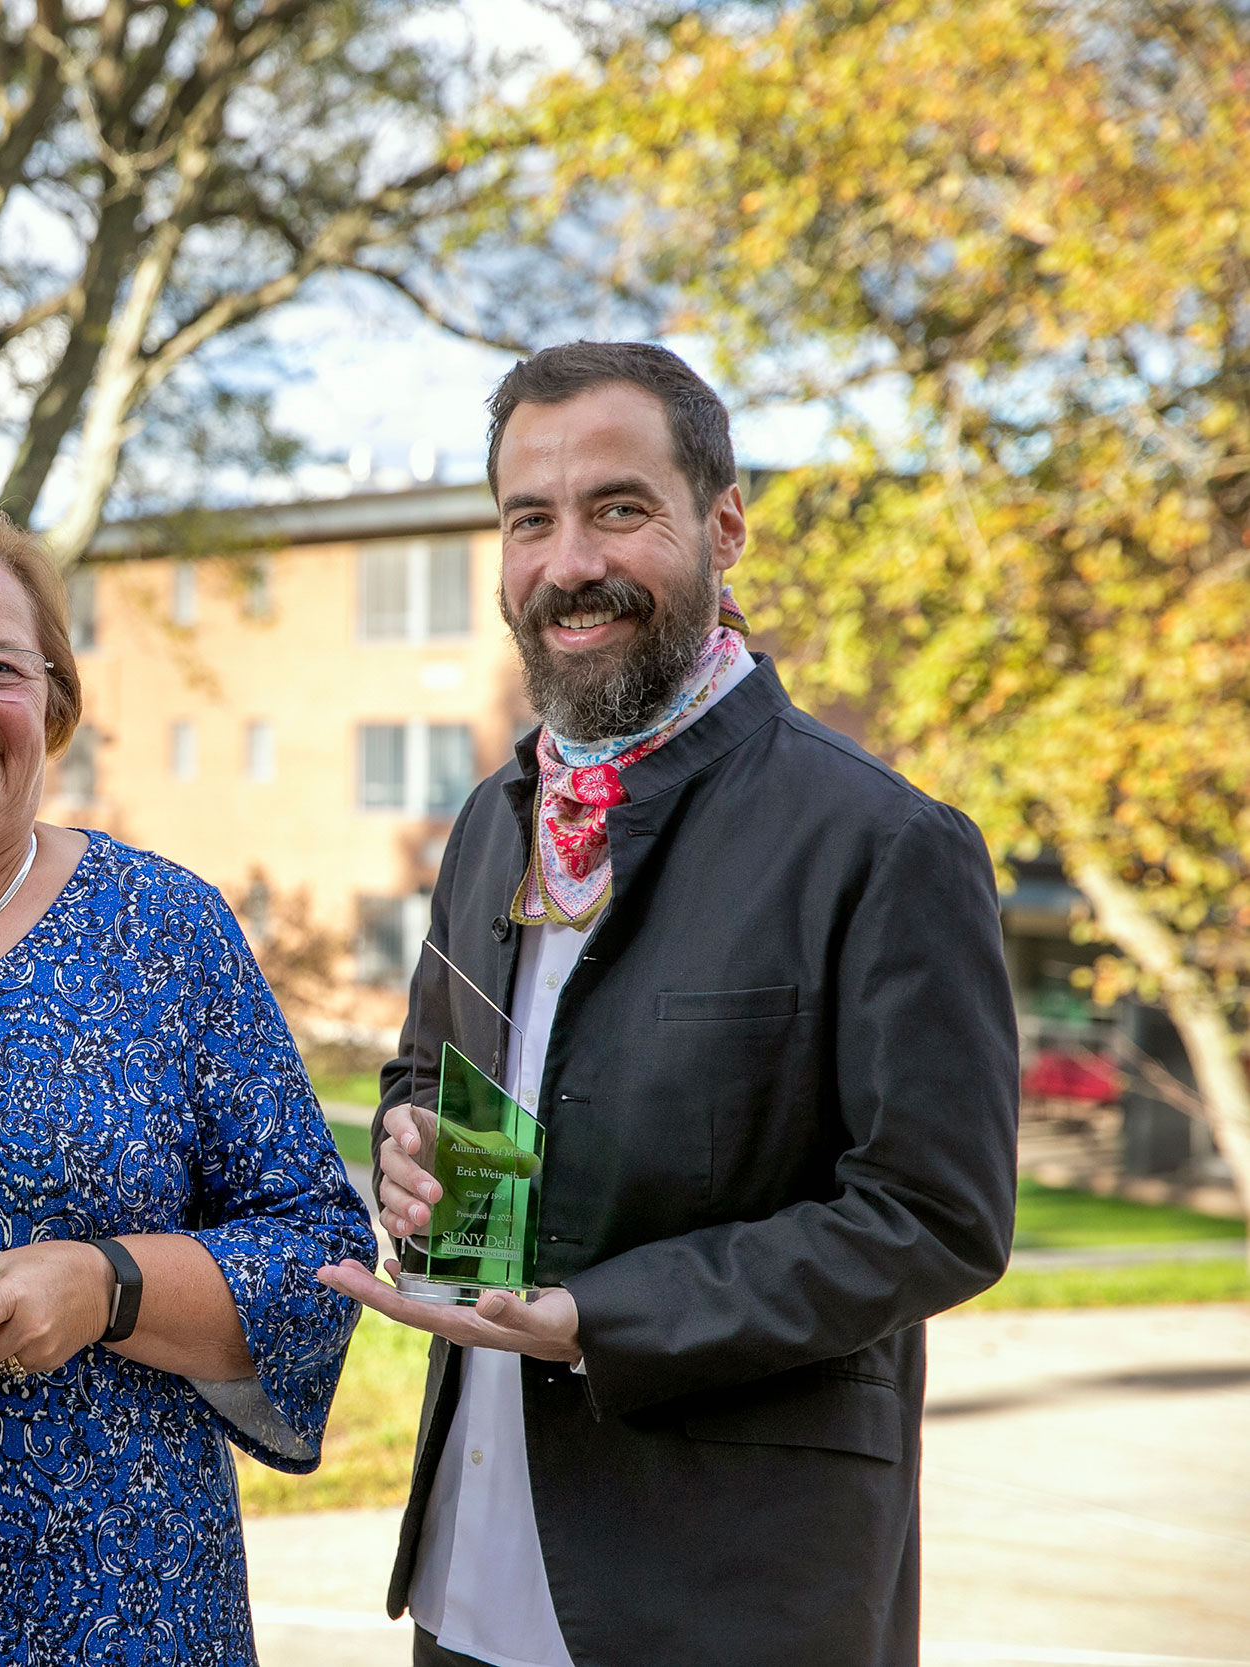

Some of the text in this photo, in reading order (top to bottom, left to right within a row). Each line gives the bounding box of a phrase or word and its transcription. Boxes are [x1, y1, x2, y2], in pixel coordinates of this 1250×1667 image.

[450, 1143, 490, 1155] Alumnus
[456, 1166, 477, 1177] Eric
[466, 1190, 482, 1199] Class
[482, 1191, 490, 1200] of
[456, 1210, 488, 1220] Presented
[442, 1231, 521, 1250] SUNY Delhi
[445, 1245, 518, 1259] Alumni Association
